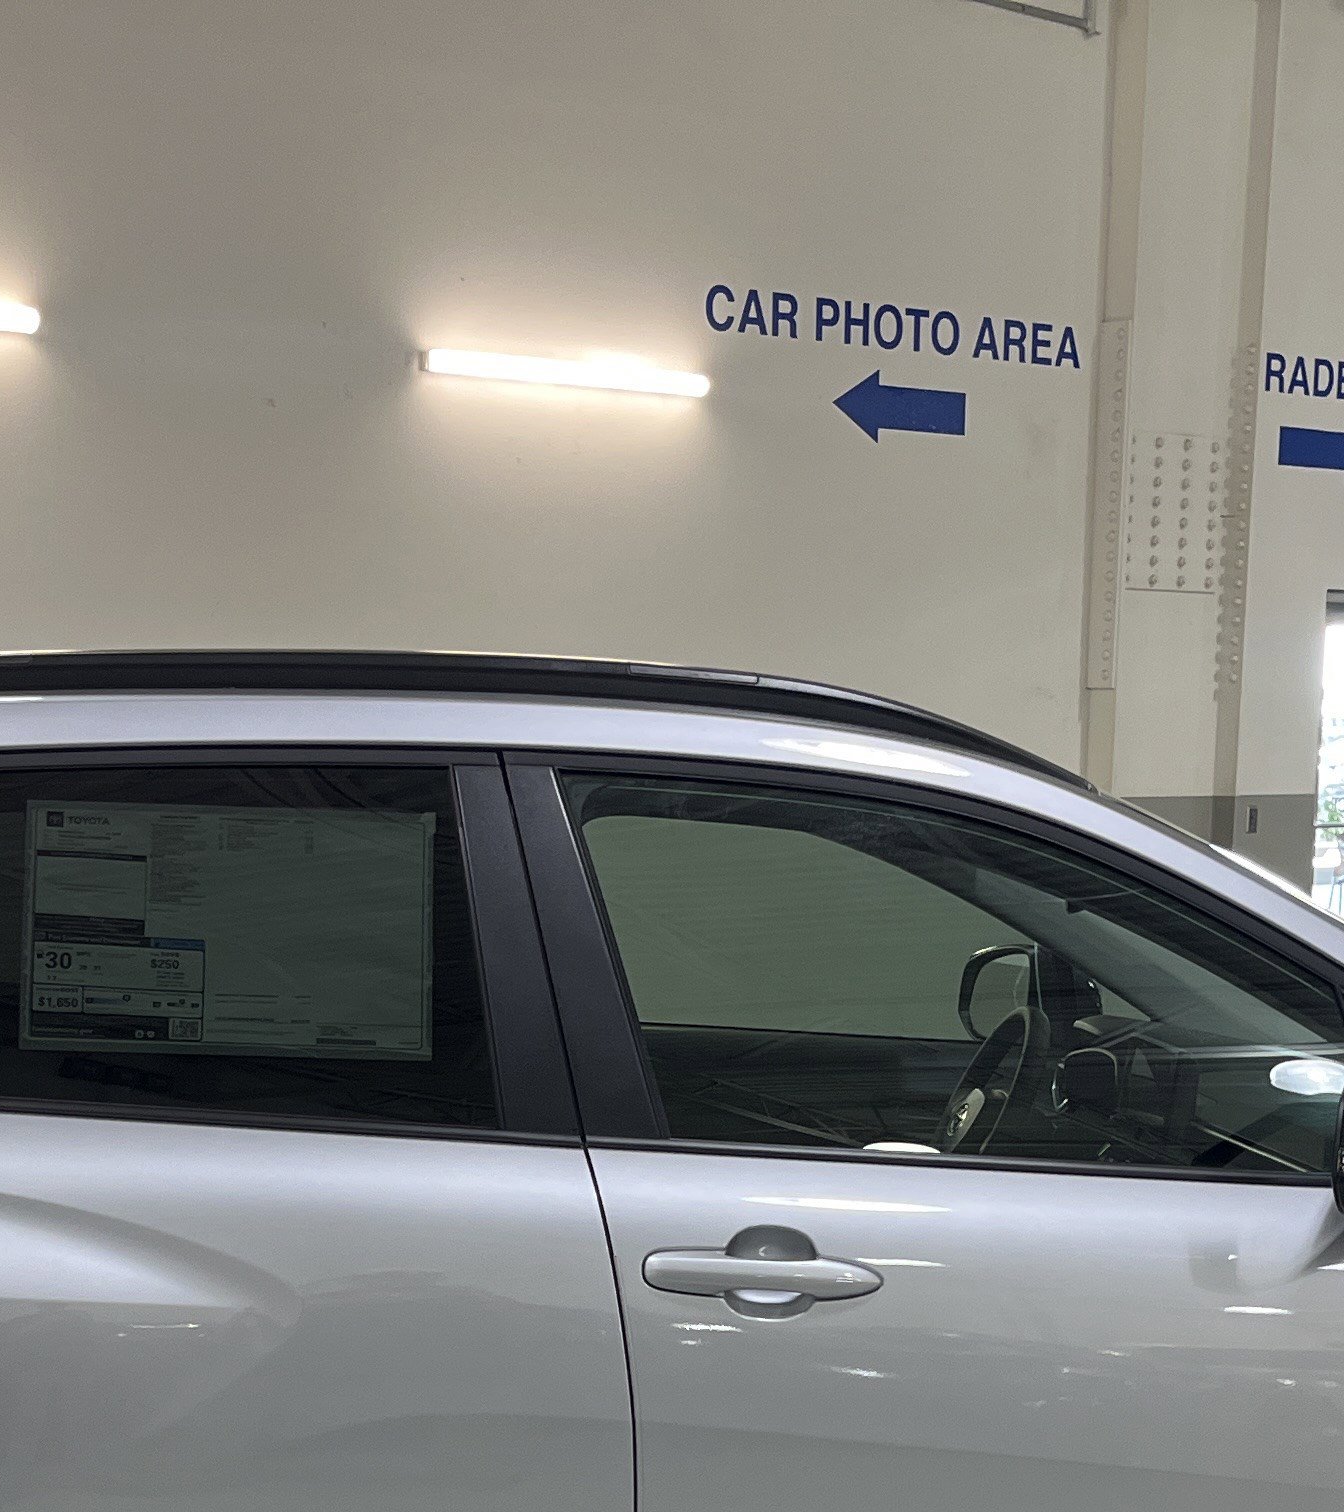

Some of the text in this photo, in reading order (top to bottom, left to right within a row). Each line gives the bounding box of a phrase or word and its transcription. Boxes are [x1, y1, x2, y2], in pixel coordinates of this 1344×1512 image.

[704, 283, 1082, 370] CAR PHOTO AREA
[67, 815, 110, 826] TOYOTA
[45, 951, 72, 970] 30
[150, 959, 180, 970] $250
